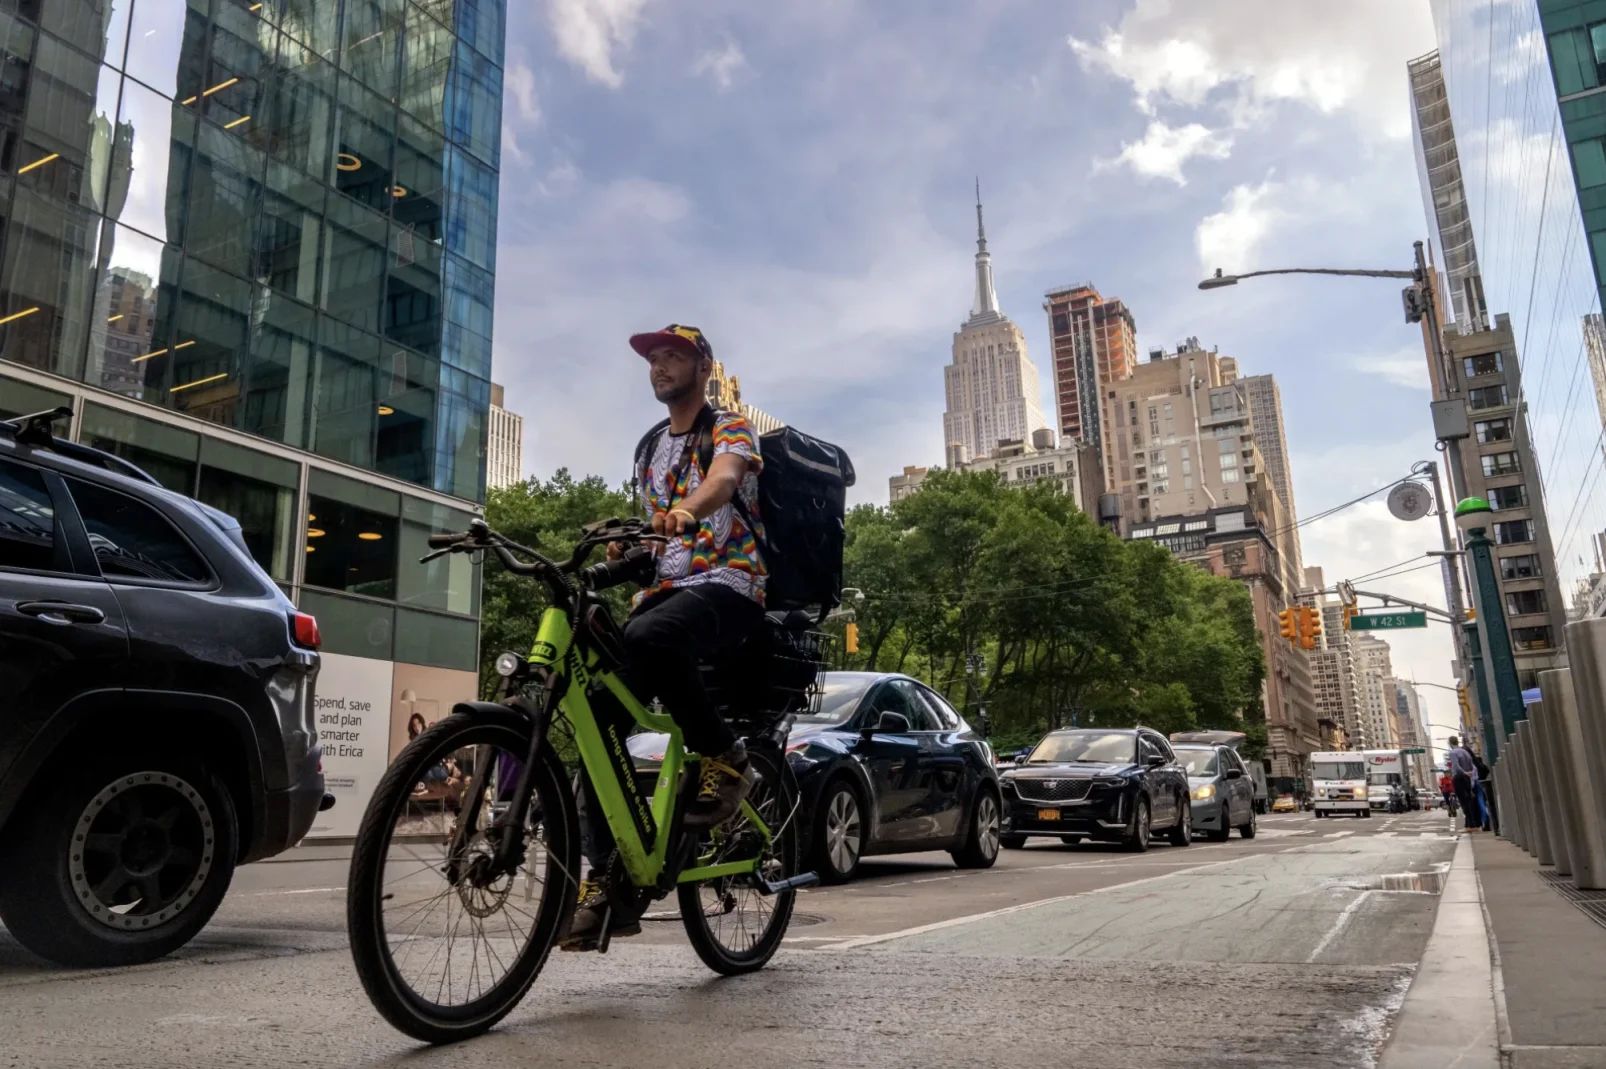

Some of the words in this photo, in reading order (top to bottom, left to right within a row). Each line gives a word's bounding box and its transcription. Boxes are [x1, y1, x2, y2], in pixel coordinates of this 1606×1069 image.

[1369, 616, 1377, 627] W
[1380, 616, 1393, 627] 42
[350, 700, 371, 712] save
[319, 713, 339, 725] and
[341, 714, 362, 728] plan
[320, 730, 360, 742] smarter
[339, 744, 363, 758] Erica
